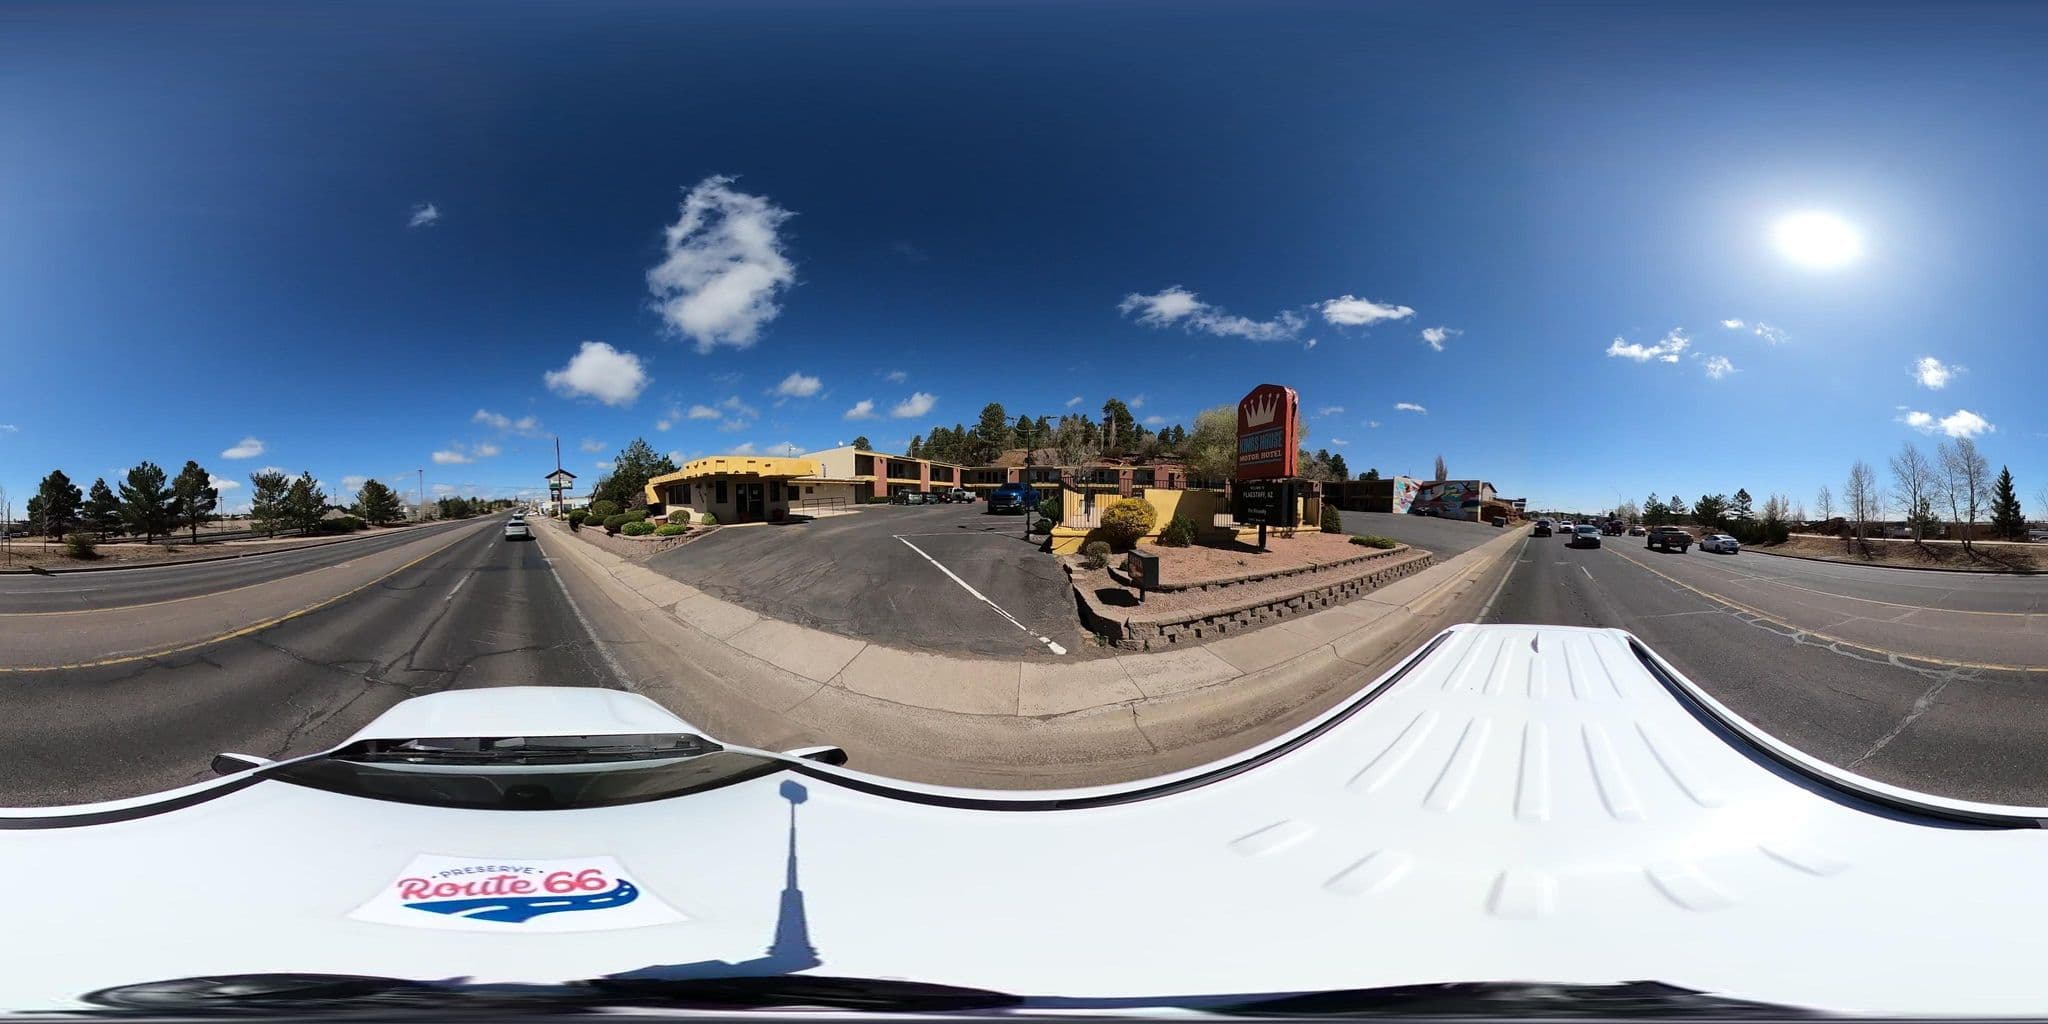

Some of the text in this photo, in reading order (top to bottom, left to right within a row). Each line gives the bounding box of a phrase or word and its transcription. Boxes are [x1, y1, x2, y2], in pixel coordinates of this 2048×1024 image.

[1240, 449, 1282, 462] MOTOR HOTEL
[439, 865, 536, 879] PRESERVE
[398, 869, 607, 900] Route 66
